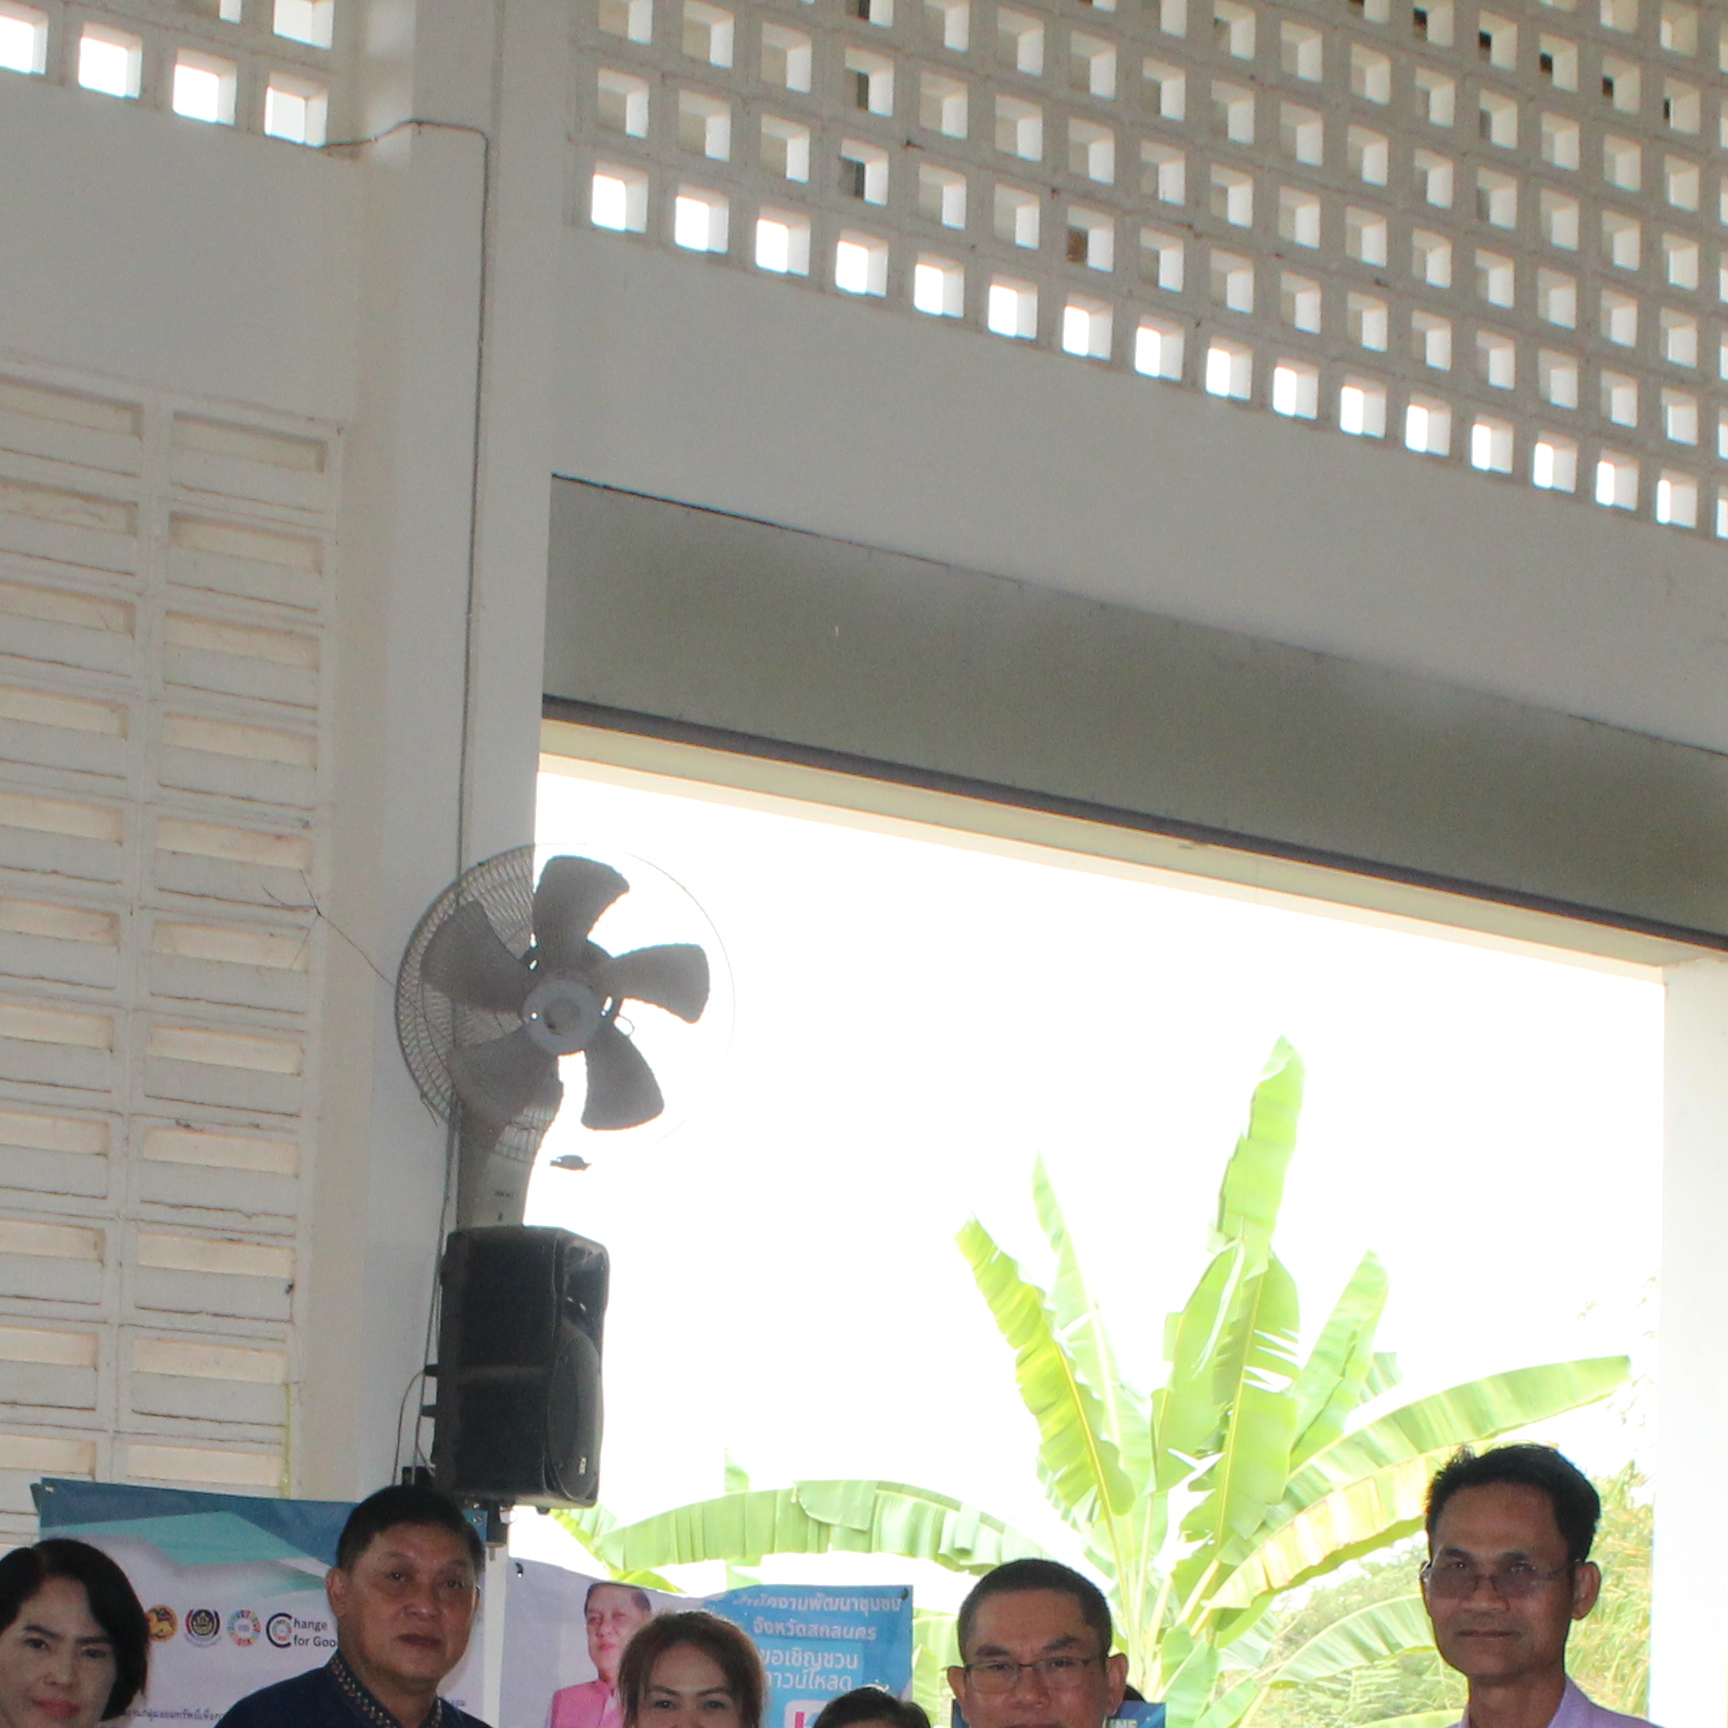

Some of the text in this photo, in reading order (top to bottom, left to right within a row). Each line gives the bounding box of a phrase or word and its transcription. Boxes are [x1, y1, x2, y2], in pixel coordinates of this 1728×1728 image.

[753, 1616, 877, 1641] จังหวัดสกลนคร
[294, 1635, 336, 1647] for Goo
